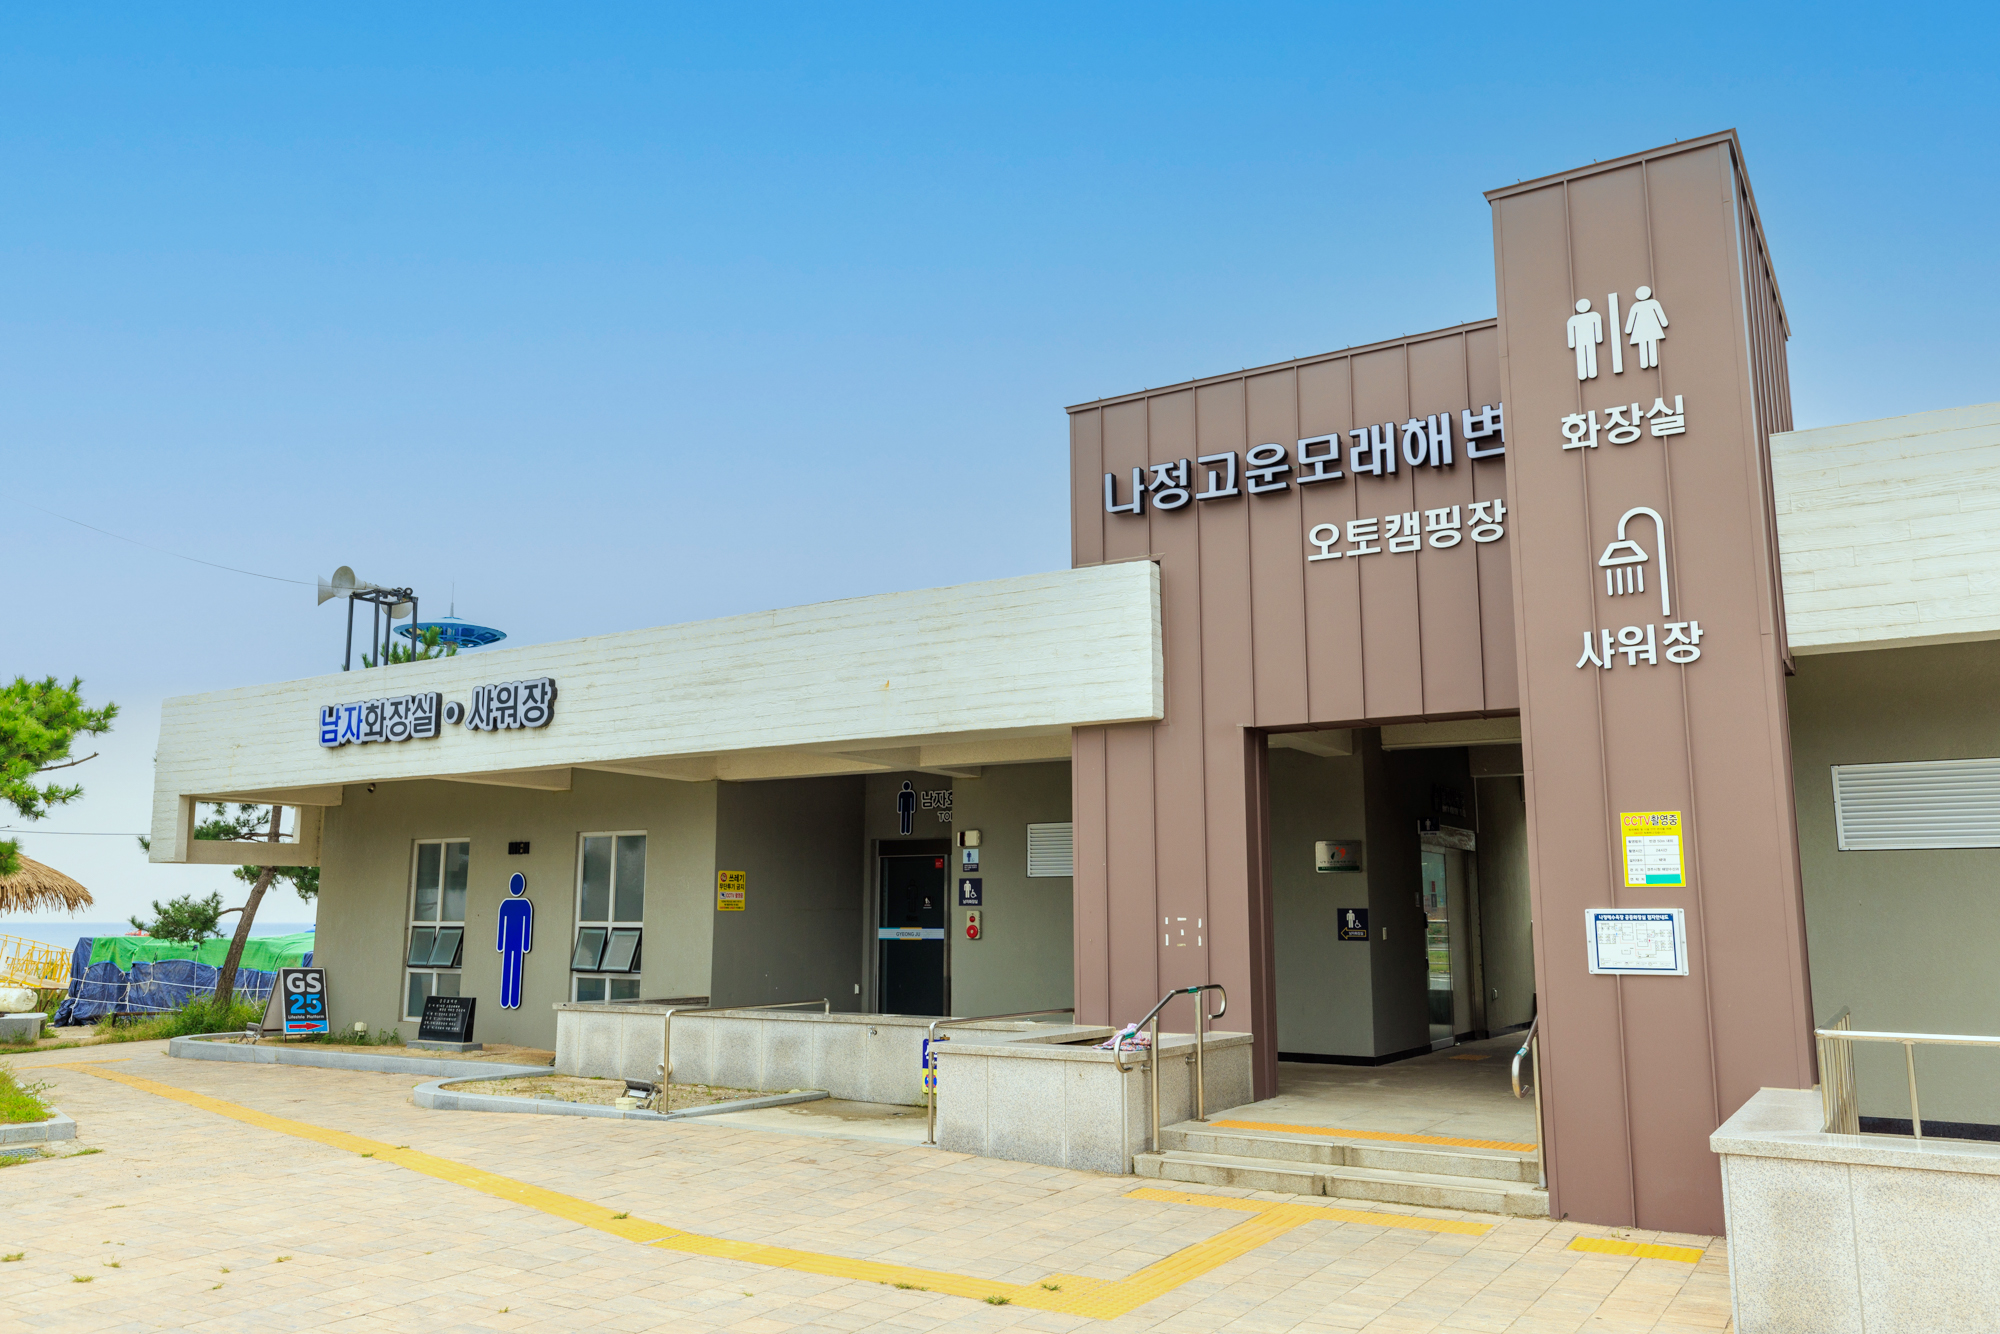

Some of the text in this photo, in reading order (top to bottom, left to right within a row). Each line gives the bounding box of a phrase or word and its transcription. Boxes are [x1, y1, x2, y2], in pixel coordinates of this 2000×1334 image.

[1561, 395, 1686, 450] 화장실
[1104, 401, 1506, 516] 나정고운모래해변
[1307, 499, 1507, 562] 오토캠핑장
[1576, 621, 1704, 670] 샤워장
[320, 694, 437, 745] 남자화장실
[466, 679, 553, 730] 샤워장
[286, 972, 322, 993] GS
[289, 994, 322, 1014] 25
